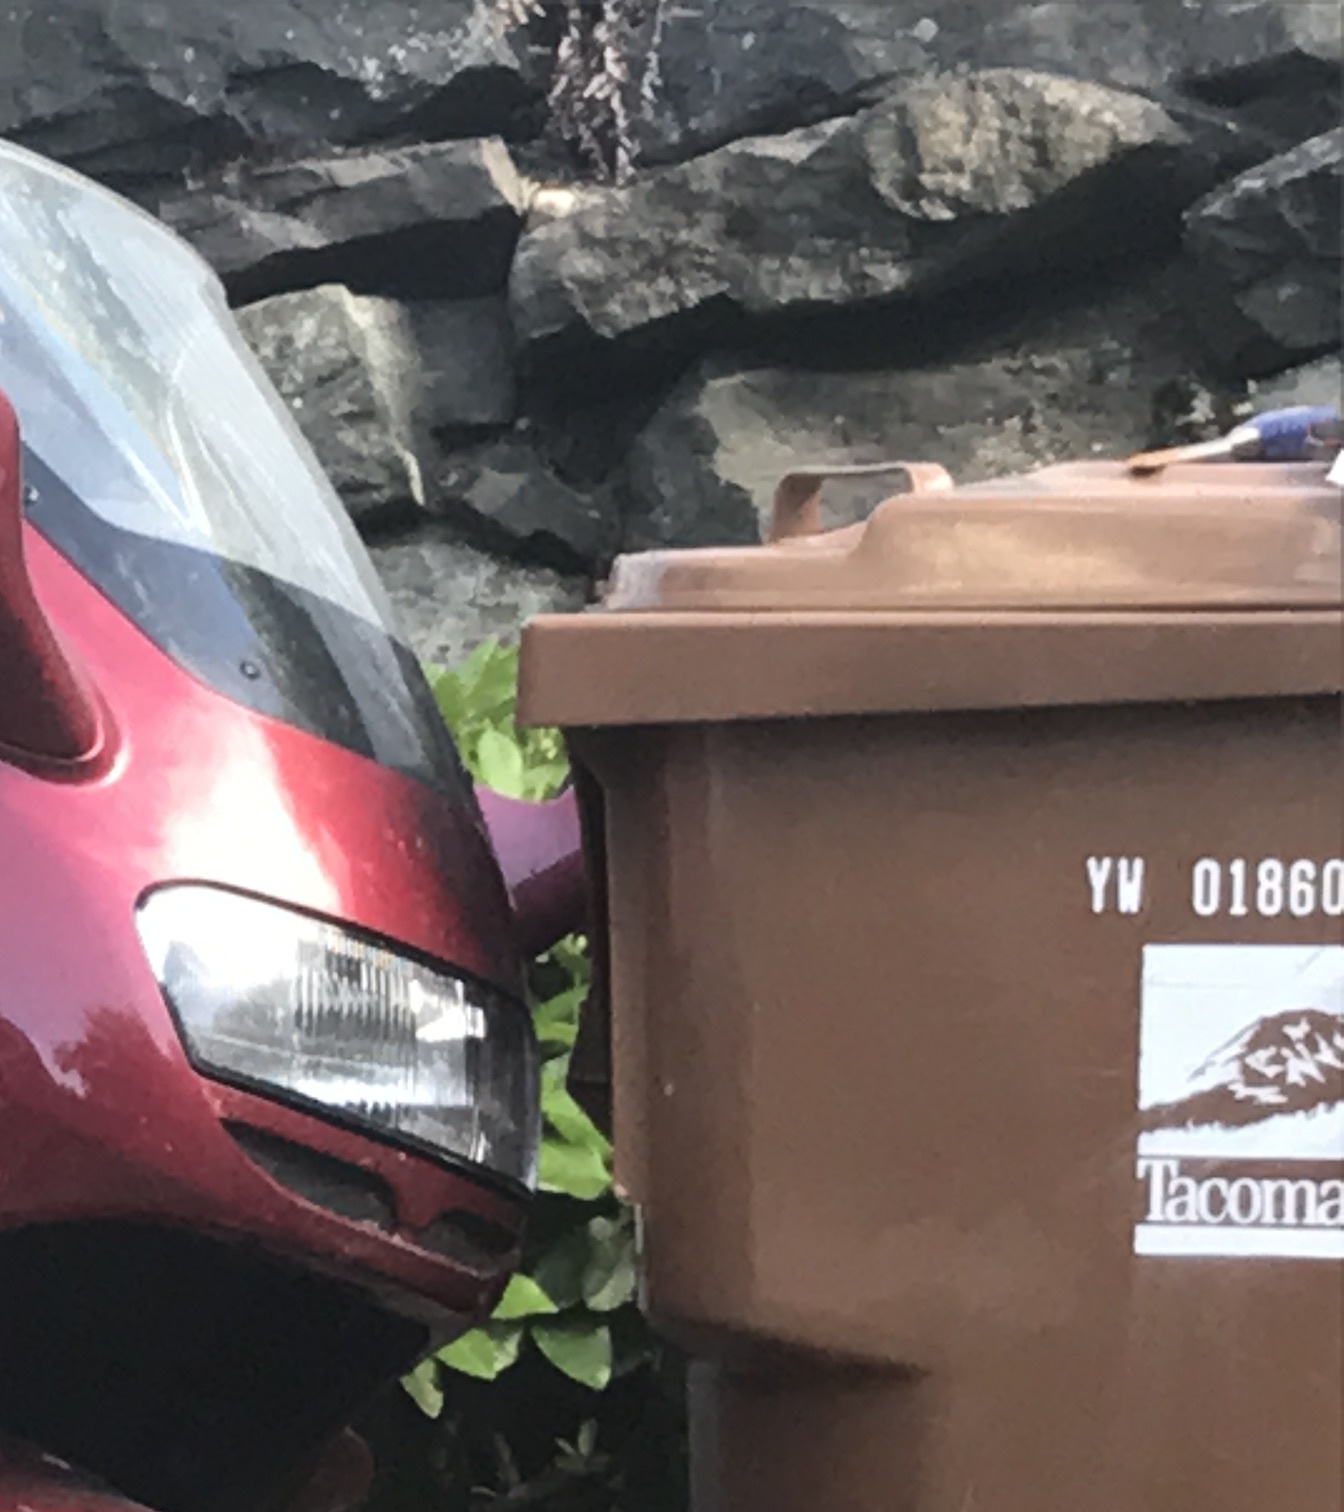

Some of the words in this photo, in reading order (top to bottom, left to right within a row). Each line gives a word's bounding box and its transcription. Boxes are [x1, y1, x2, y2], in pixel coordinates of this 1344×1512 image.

[1086, 856, 1145, 914] YW
[1192, 858, 1344, 917] 01860
[1137, 1159, 1344, 1225] Tacoma
